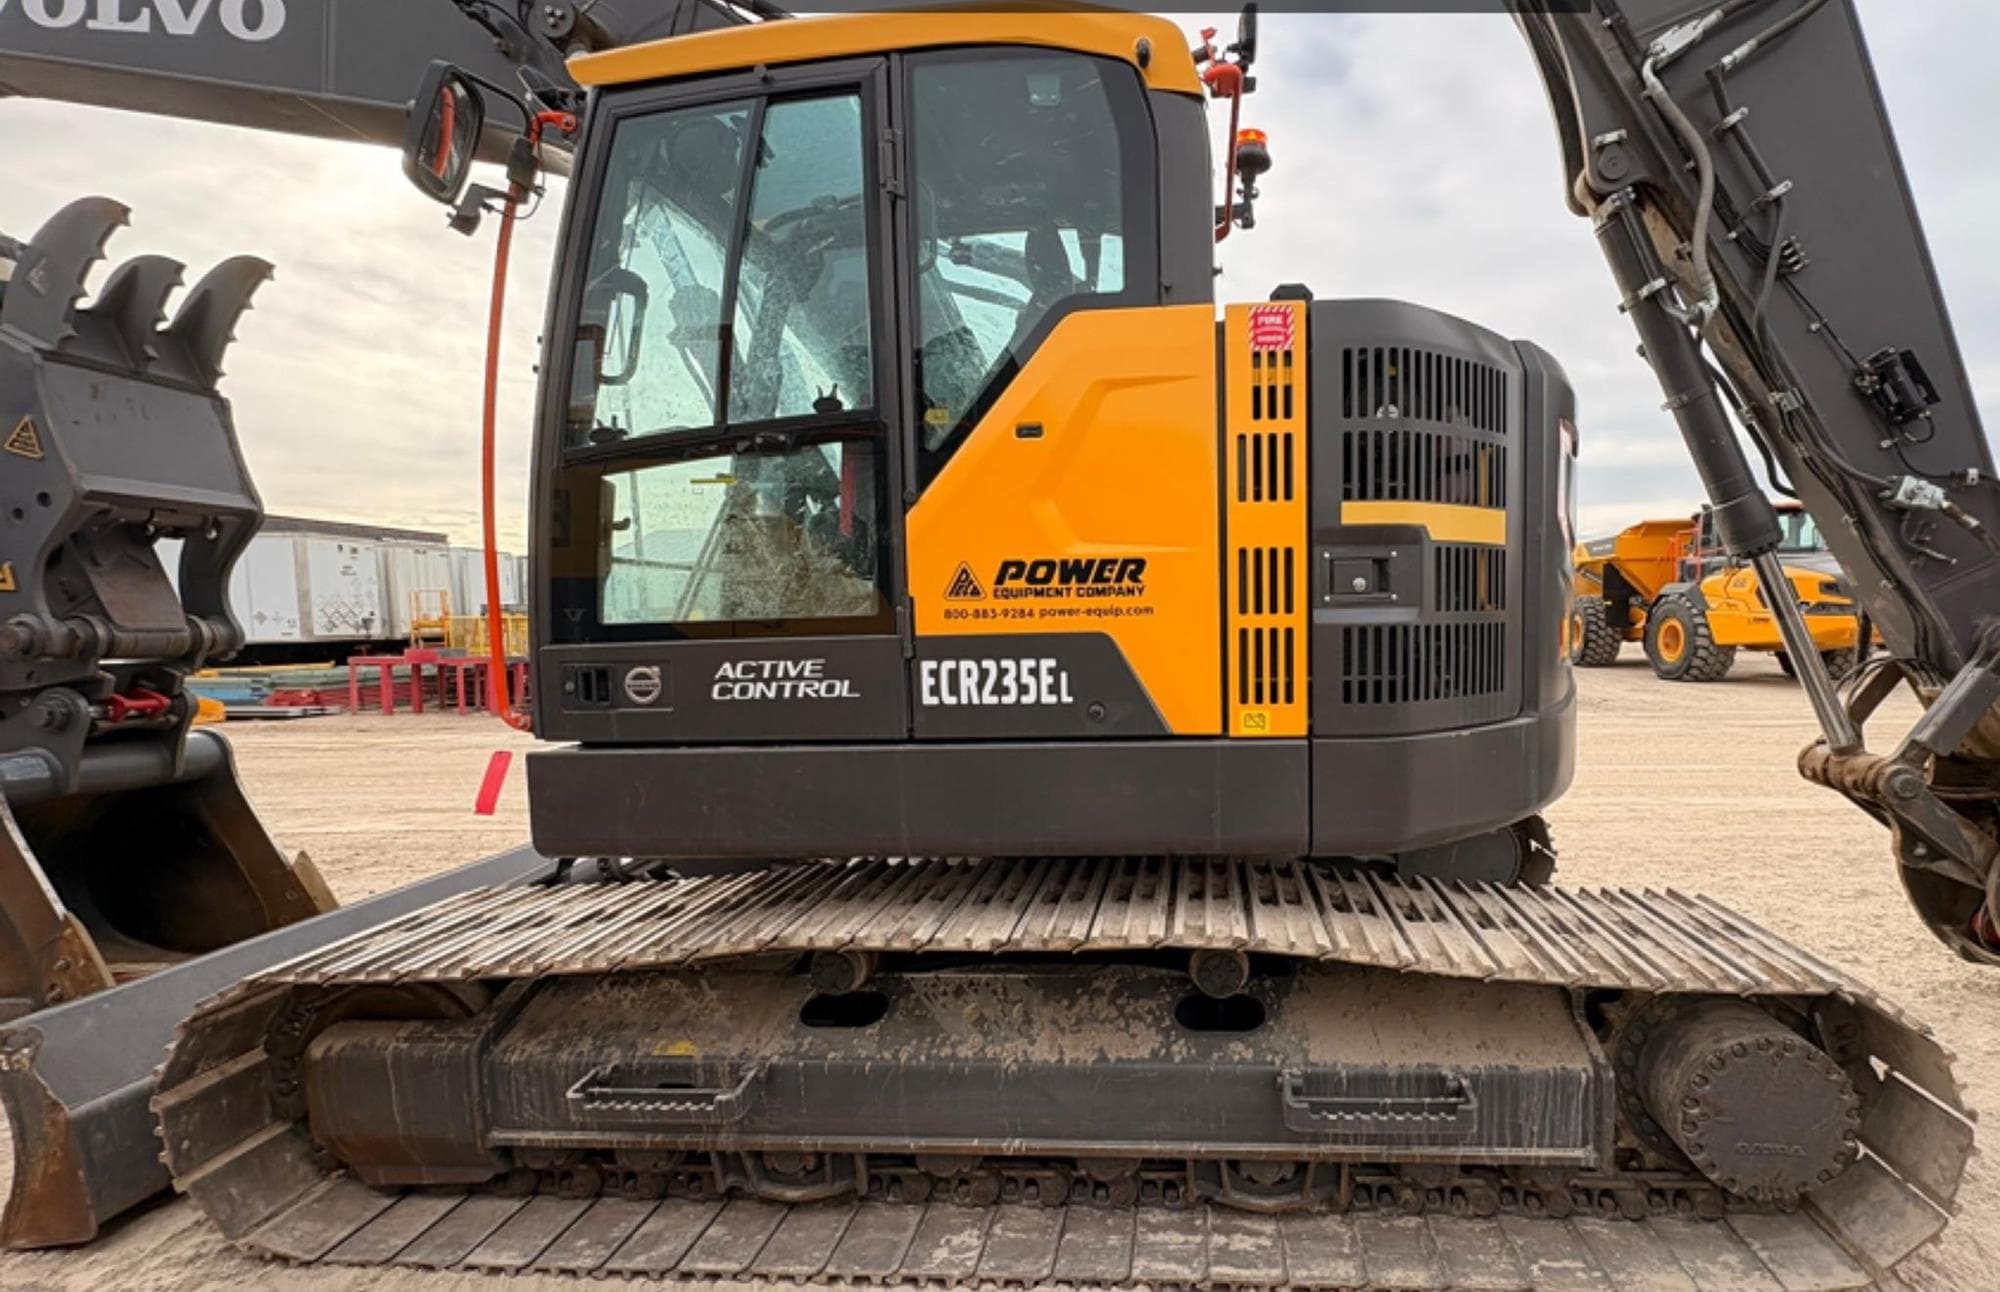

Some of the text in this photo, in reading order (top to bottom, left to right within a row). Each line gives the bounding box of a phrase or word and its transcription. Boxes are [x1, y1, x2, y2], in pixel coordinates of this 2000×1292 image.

[0, 0, 287, 41] OLVO
[993, 558, 1147, 586] POWER
[992, 585, 1145, 600] EQUIPMENT COMPANY
[1039, 604, 1154, 619] power-equip.com
[713, 658, 826, 680] ACTIVE
[711, 679, 862, 700] CONTROL
